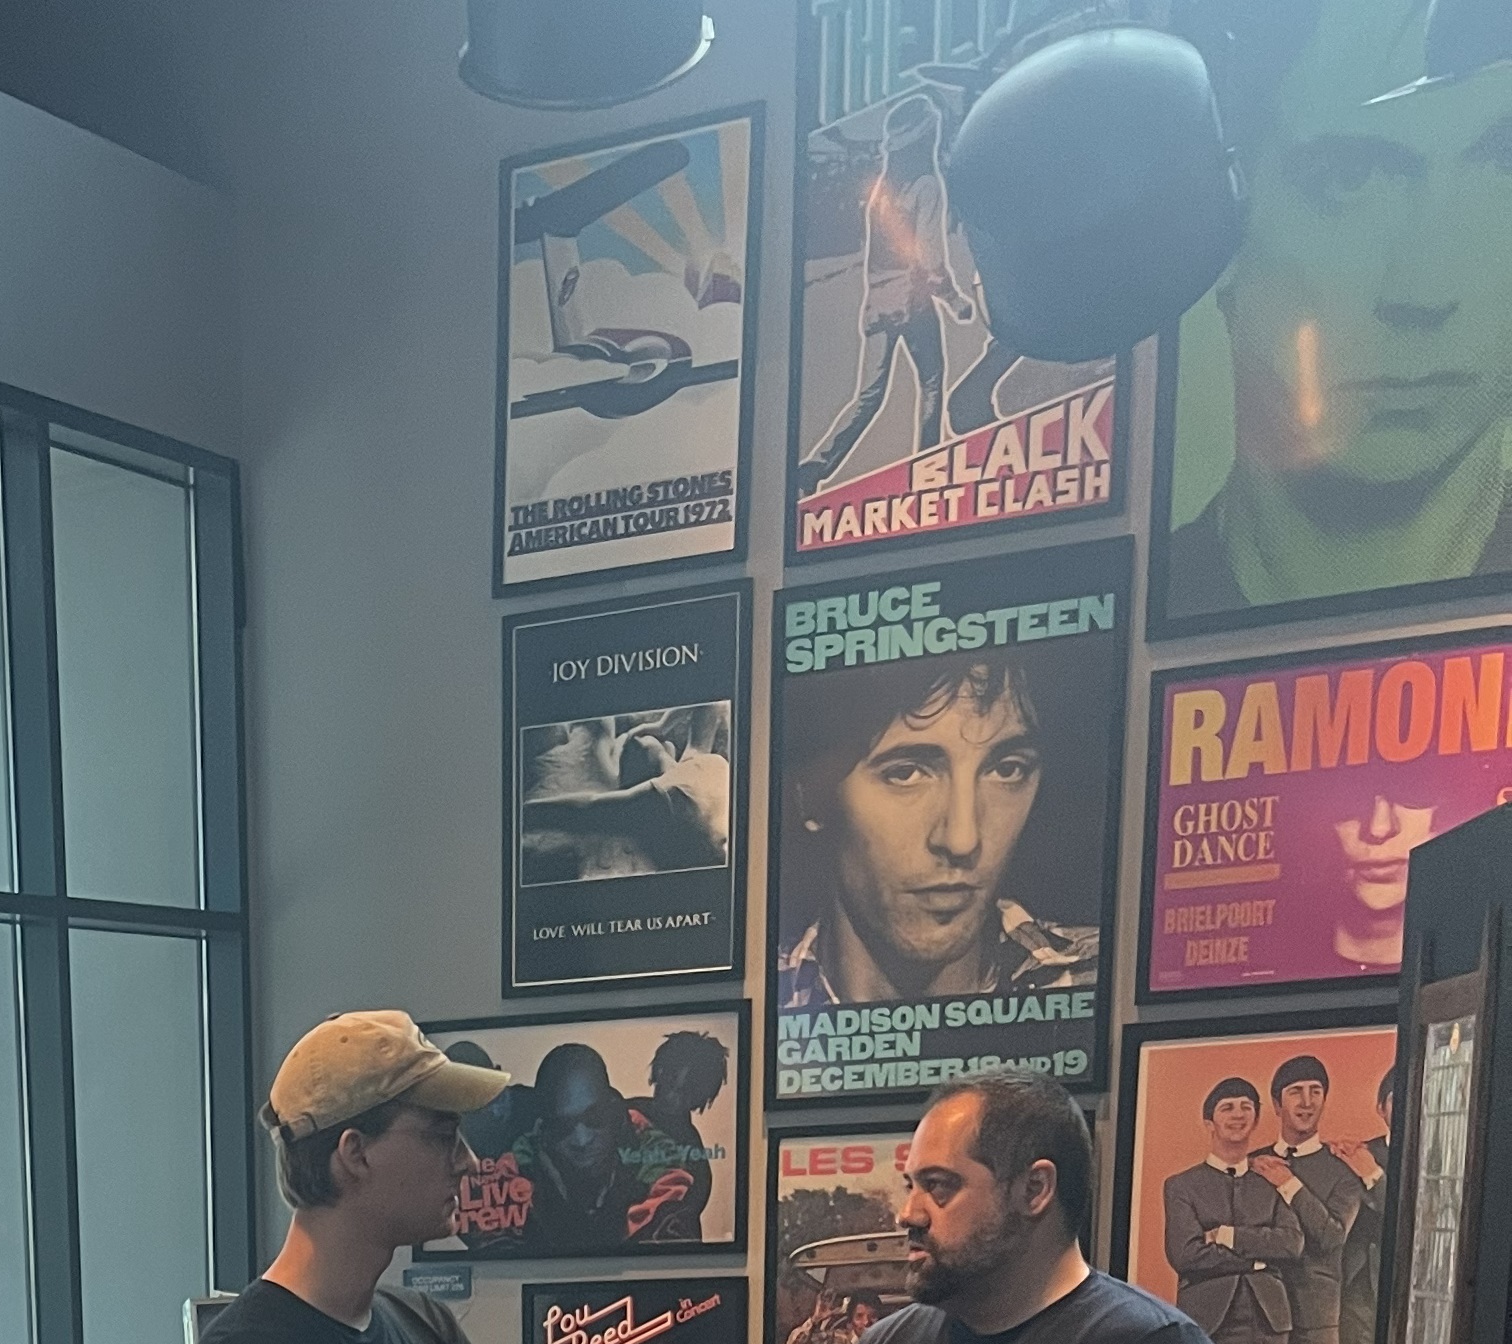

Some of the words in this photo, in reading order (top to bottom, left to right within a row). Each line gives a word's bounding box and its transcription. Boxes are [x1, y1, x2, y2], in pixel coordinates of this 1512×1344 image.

[912, 384, 1115, 492] BLACK
[510, 502, 548, 526] THE
[552, 485, 644, 519] ROLLING
[646, 470, 733, 501] STONES
[802, 487, 965, 545] MARKET
[977, 463, 1111, 518] CLASH
[508, 517, 620, 552] AMERICAN
[621, 506, 680, 534] TOUR
[682, 499, 733, 527] 1972
[785, 593, 1116, 674] SPRINGSTEEN
[786, 581, 941, 638] BRUCE
[552, 659, 590, 683] JOY
[596, 643, 699, 677] DIVISION
[1168, 651, 1512, 787] RAMON
[1173, 795, 1279, 838] GHOST
[1172, 830, 1275, 869] DANCE
[532, 926, 565, 942] LOVE
[571, 922, 604, 938] WILL
[607, 919, 642, 935] TEAR
[646, 916, 663, 931] US
[664, 911, 712, 929] APART
[1185, 935, 1250, 967] DEINZE
[778, 1004, 940, 1041] MADISON
[944, 992, 1094, 1026] SQUARE
[777, 1031, 921, 1066] GARDEN
[777, 1058, 960, 1096] DECEMBER
[1053, 1049, 1088, 1077] 19
[781, 1145, 875, 1177] LES
